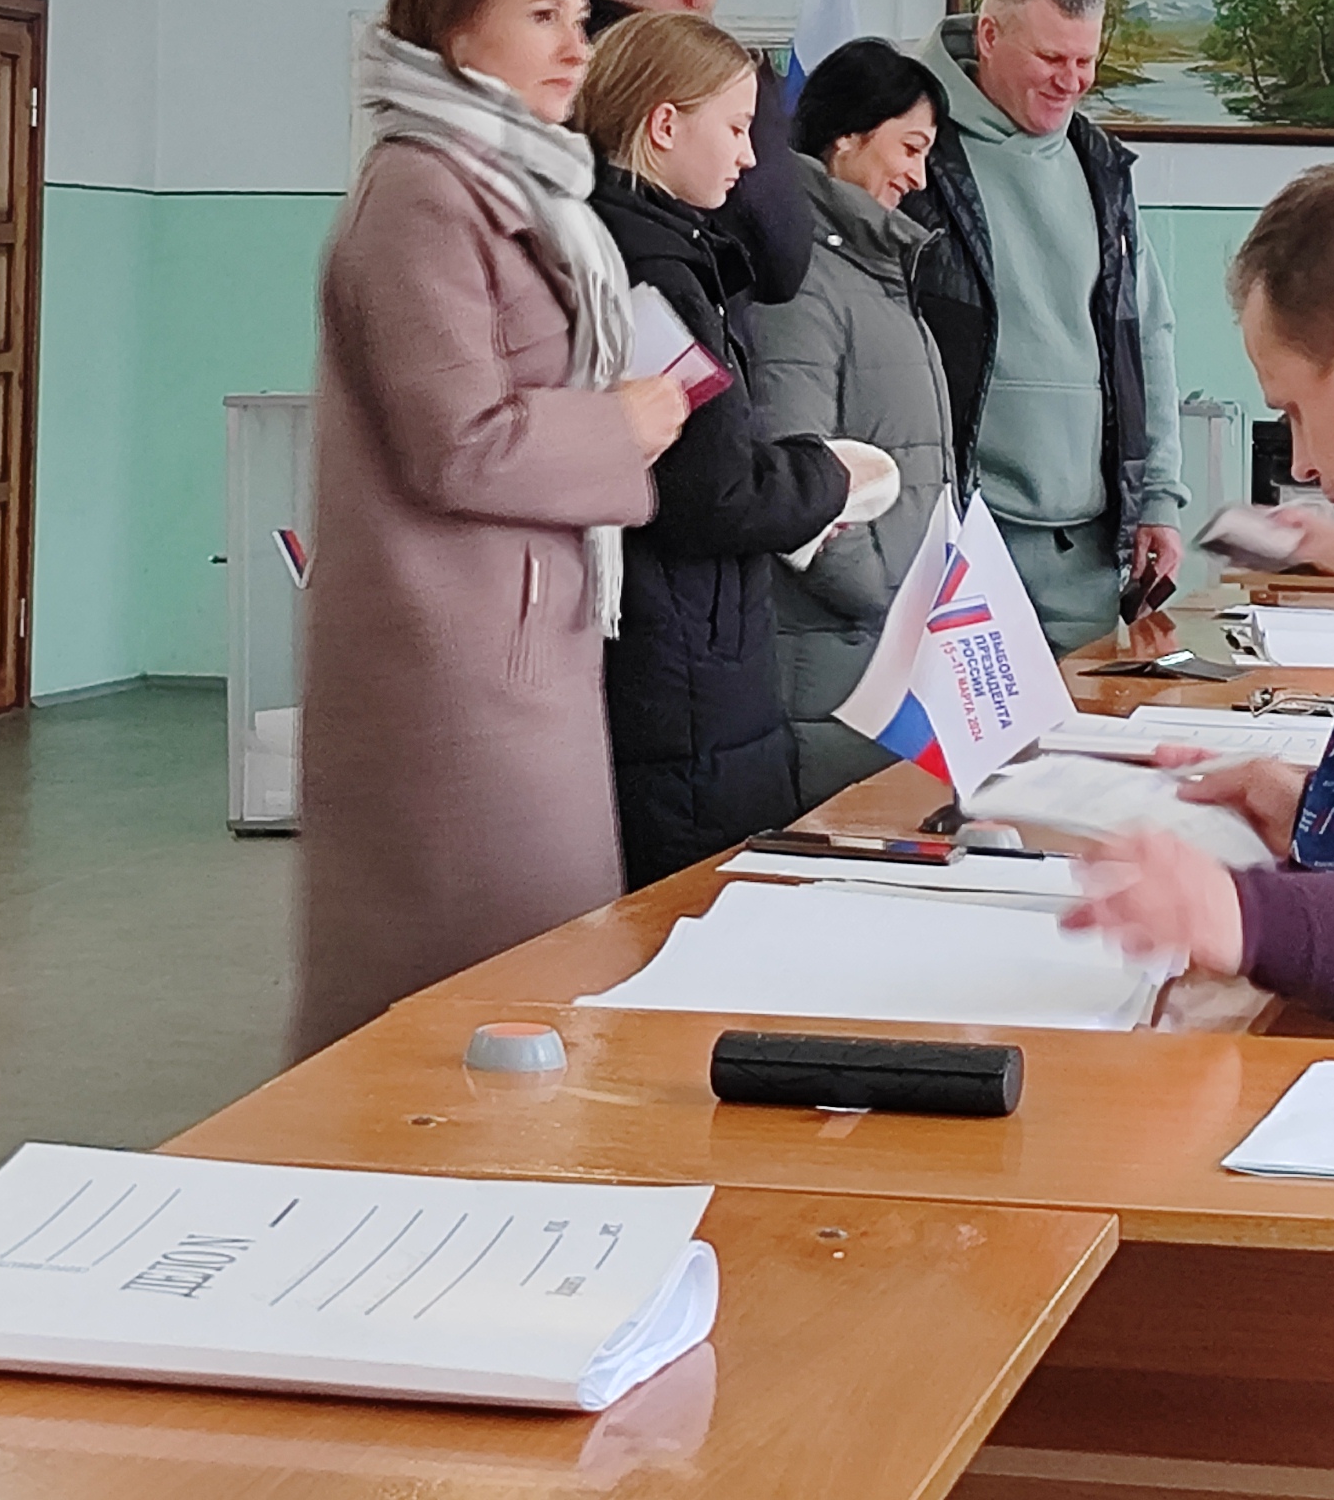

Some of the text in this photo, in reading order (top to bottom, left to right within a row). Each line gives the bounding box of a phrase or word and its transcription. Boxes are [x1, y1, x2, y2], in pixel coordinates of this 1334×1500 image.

[957, 638, 986, 698] РОССИИ
[973, 634, 1012, 730] ПРЕЗИДЕНТА
[988, 630, 1019, 697] ВЫБОРЫ
[120, 1250, 237, 1299] ДЕЛО
